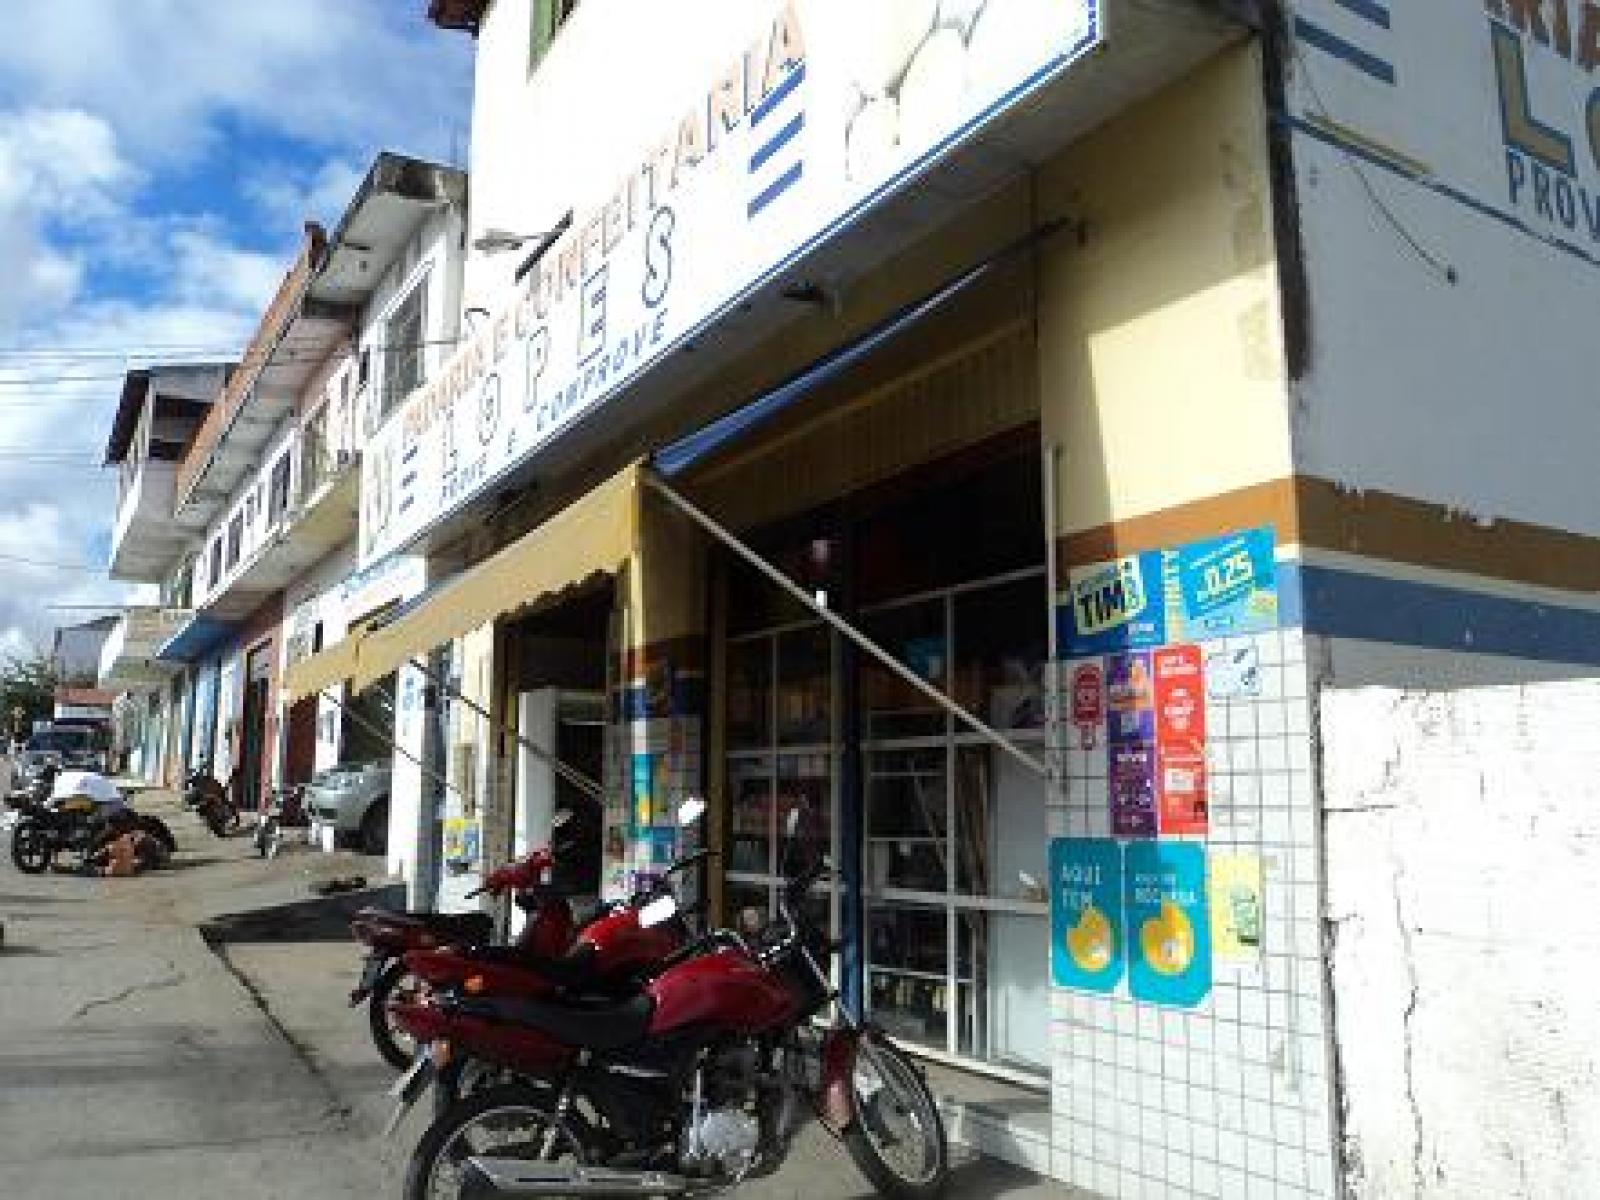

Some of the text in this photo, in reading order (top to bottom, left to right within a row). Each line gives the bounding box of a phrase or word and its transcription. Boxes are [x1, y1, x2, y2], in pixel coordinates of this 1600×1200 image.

[1489, 19, 1600, 180] L
[442, 203, 677, 480] LOPES
[535, 305, 669, 432] COMPROVE
[1077, 577, 1127, 628] TIM
